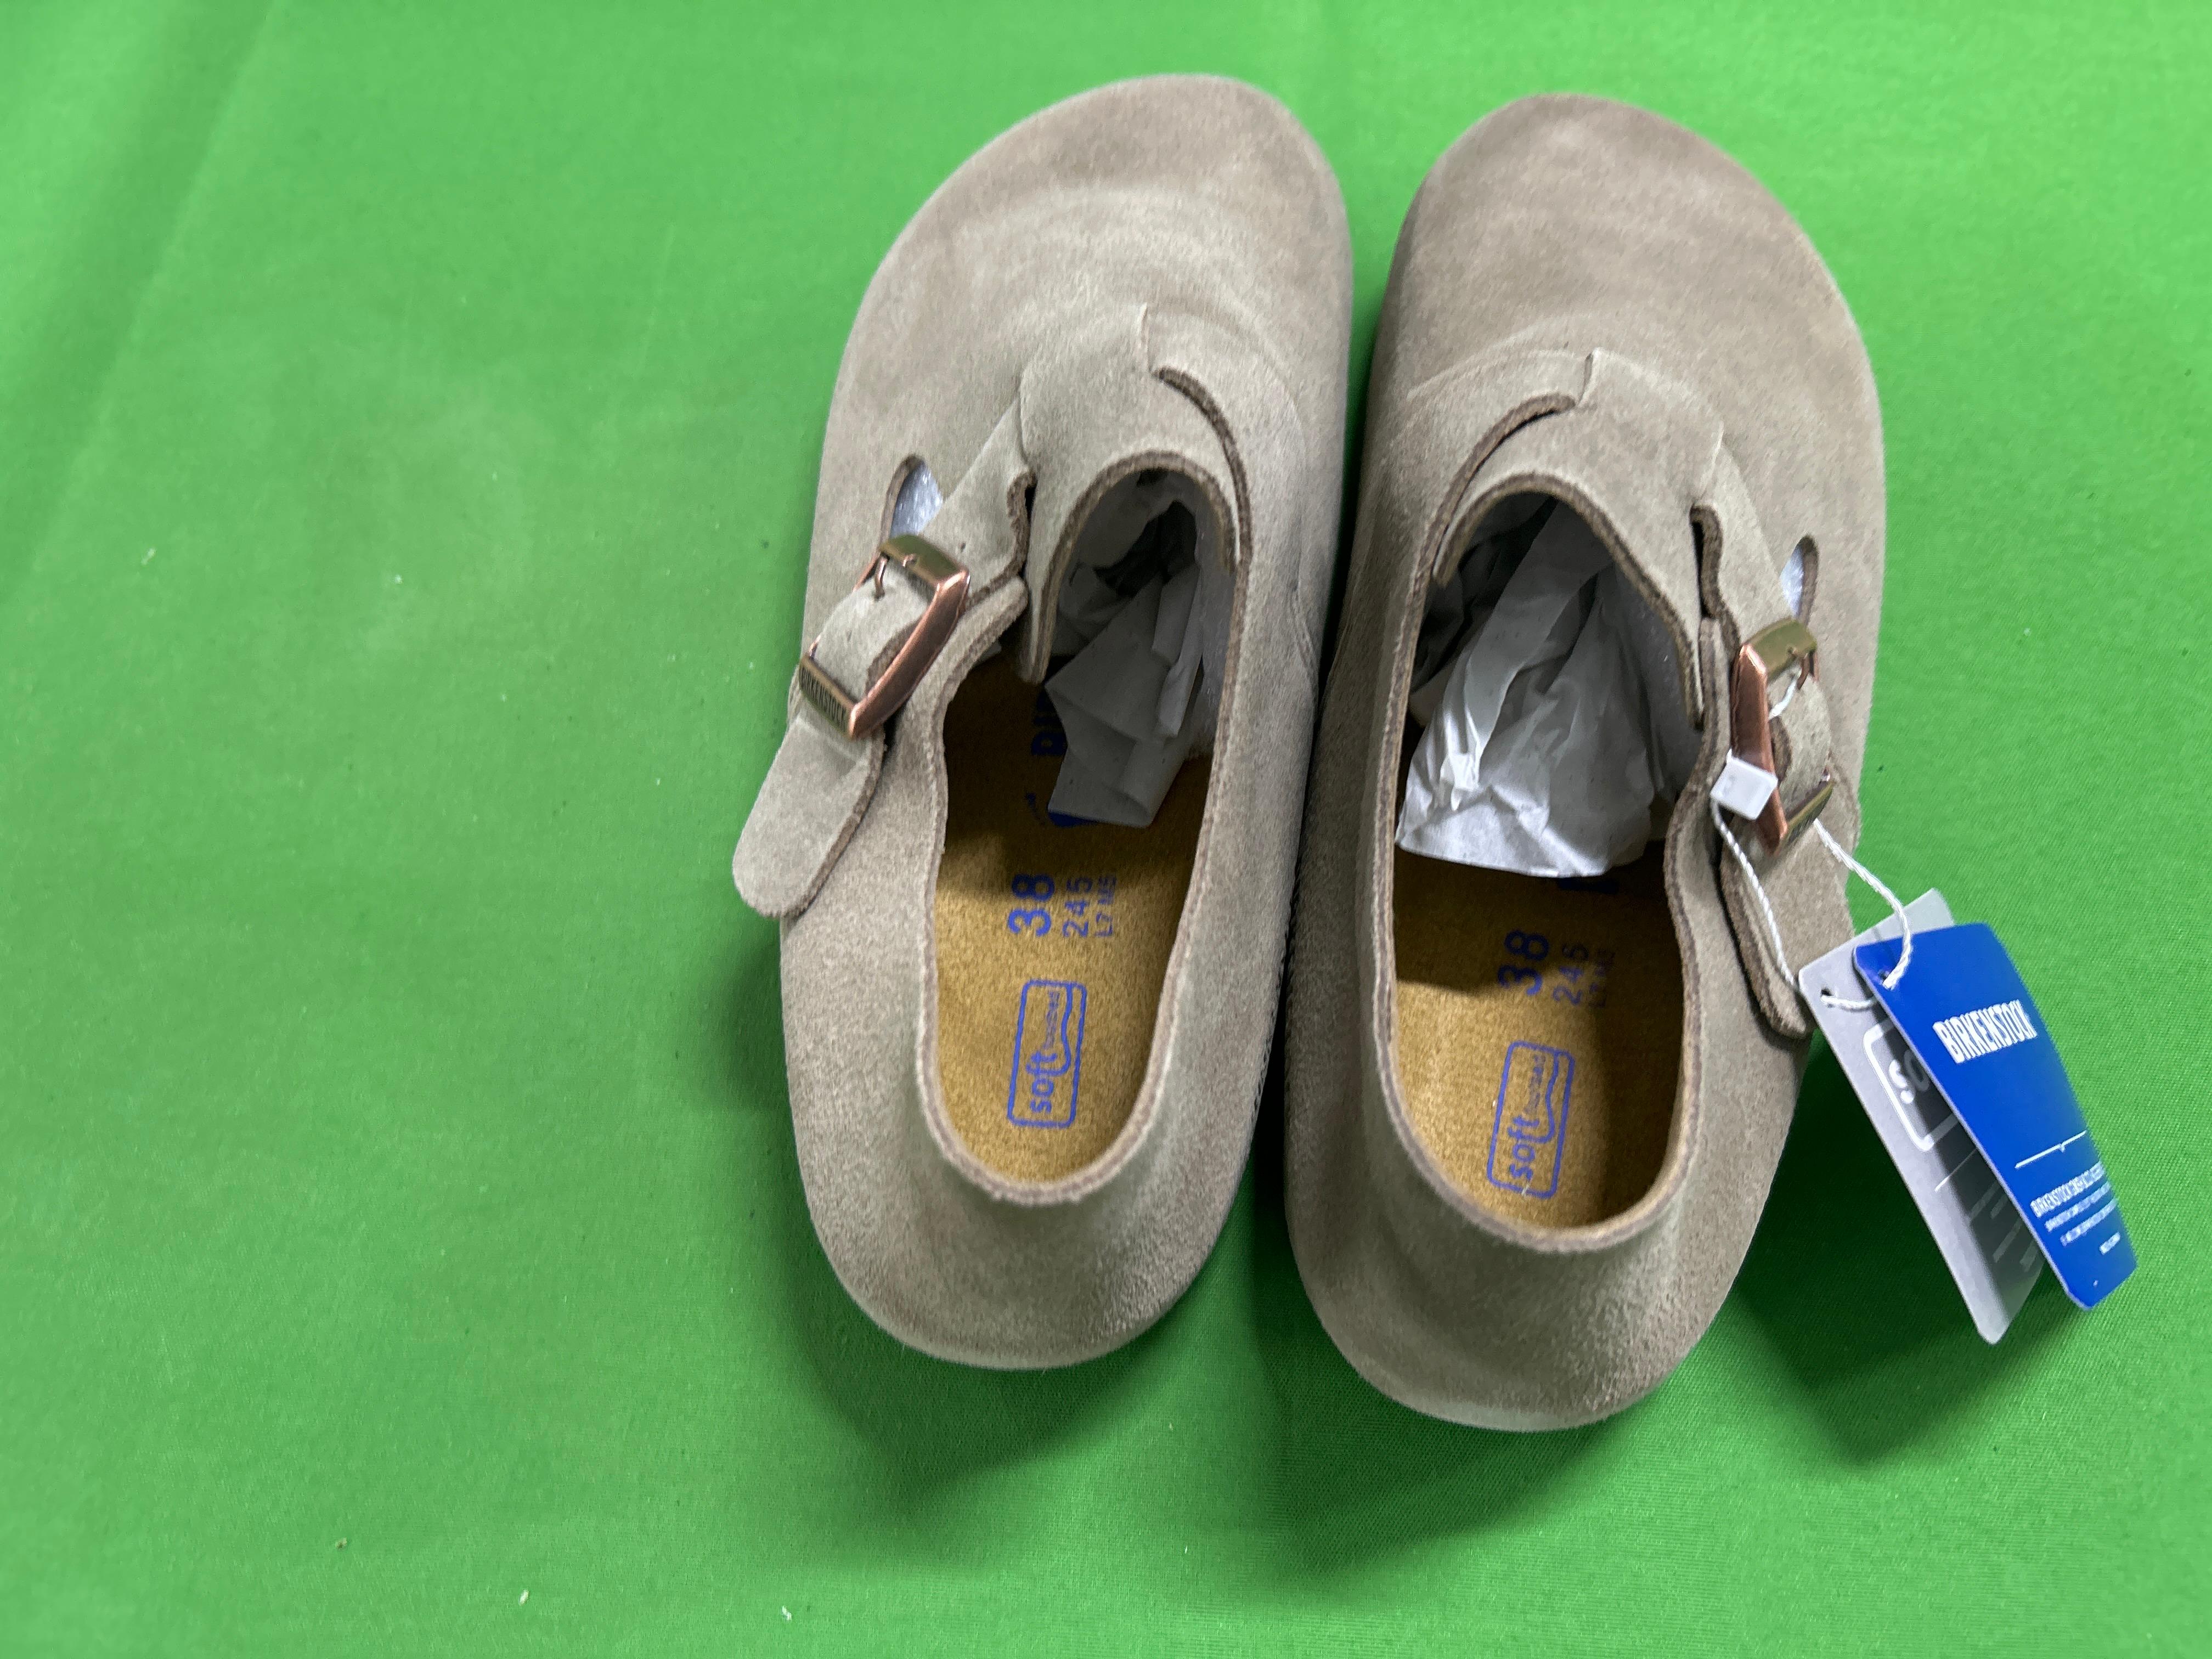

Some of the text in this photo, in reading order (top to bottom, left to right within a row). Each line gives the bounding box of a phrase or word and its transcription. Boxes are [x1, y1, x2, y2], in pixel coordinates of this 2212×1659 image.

[1007, 873, 1054, 938] 38
[1062, 878, 1093, 938] 245
[1497, 930, 1550, 996] 38
[1552, 943, 1590, 1006] 245
[1932, 999, 2039, 1064] BIRKENSTOCK
[1025, 1051, 1064, 1114] soft
[1506, 1115, 1547, 1181] soft
